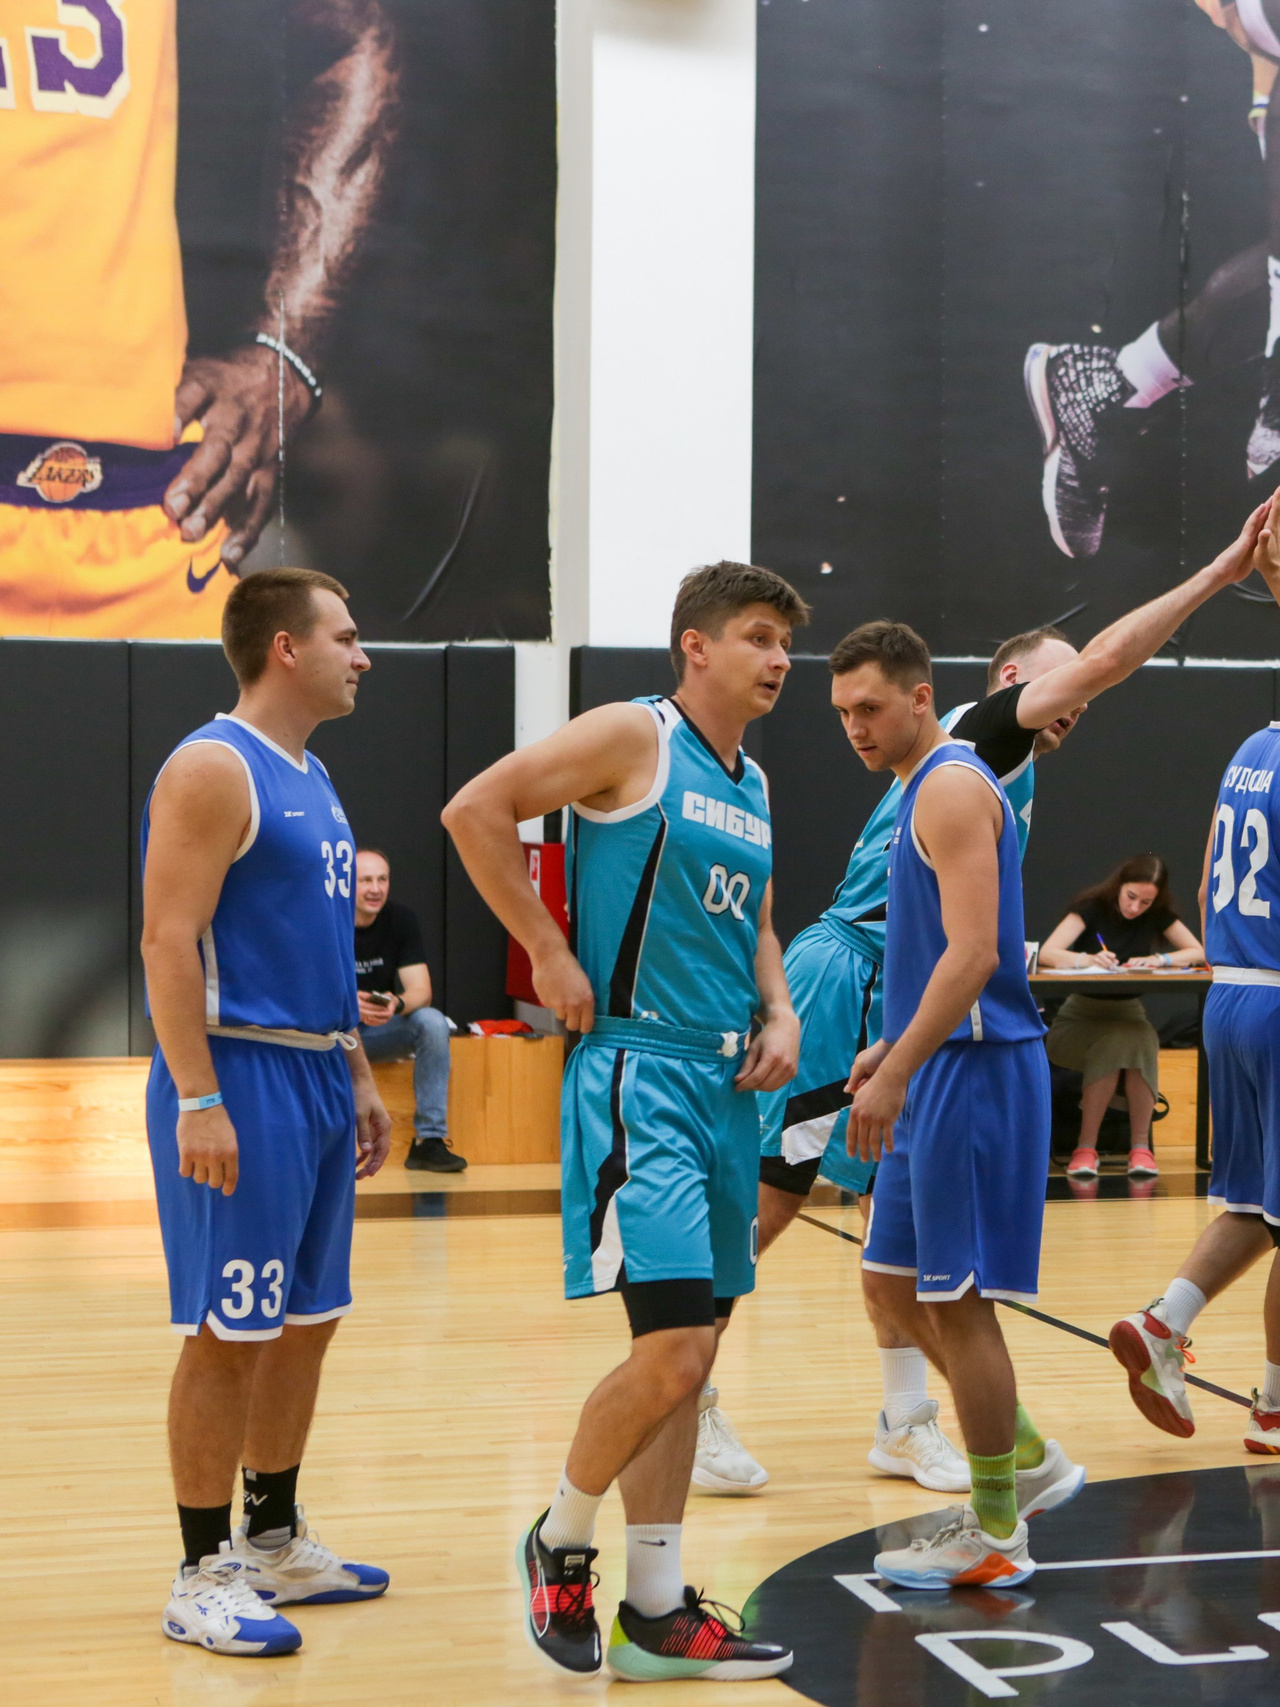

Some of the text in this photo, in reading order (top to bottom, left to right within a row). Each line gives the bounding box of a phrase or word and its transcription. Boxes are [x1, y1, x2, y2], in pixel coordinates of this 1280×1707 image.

[681, 790, 772, 850] СИБУР
[321, 839, 354, 899] 33
[1212, 803, 1271, 919] 92
[701, 862, 751, 922] 00
[221, 1258, 285, 1319] 33
